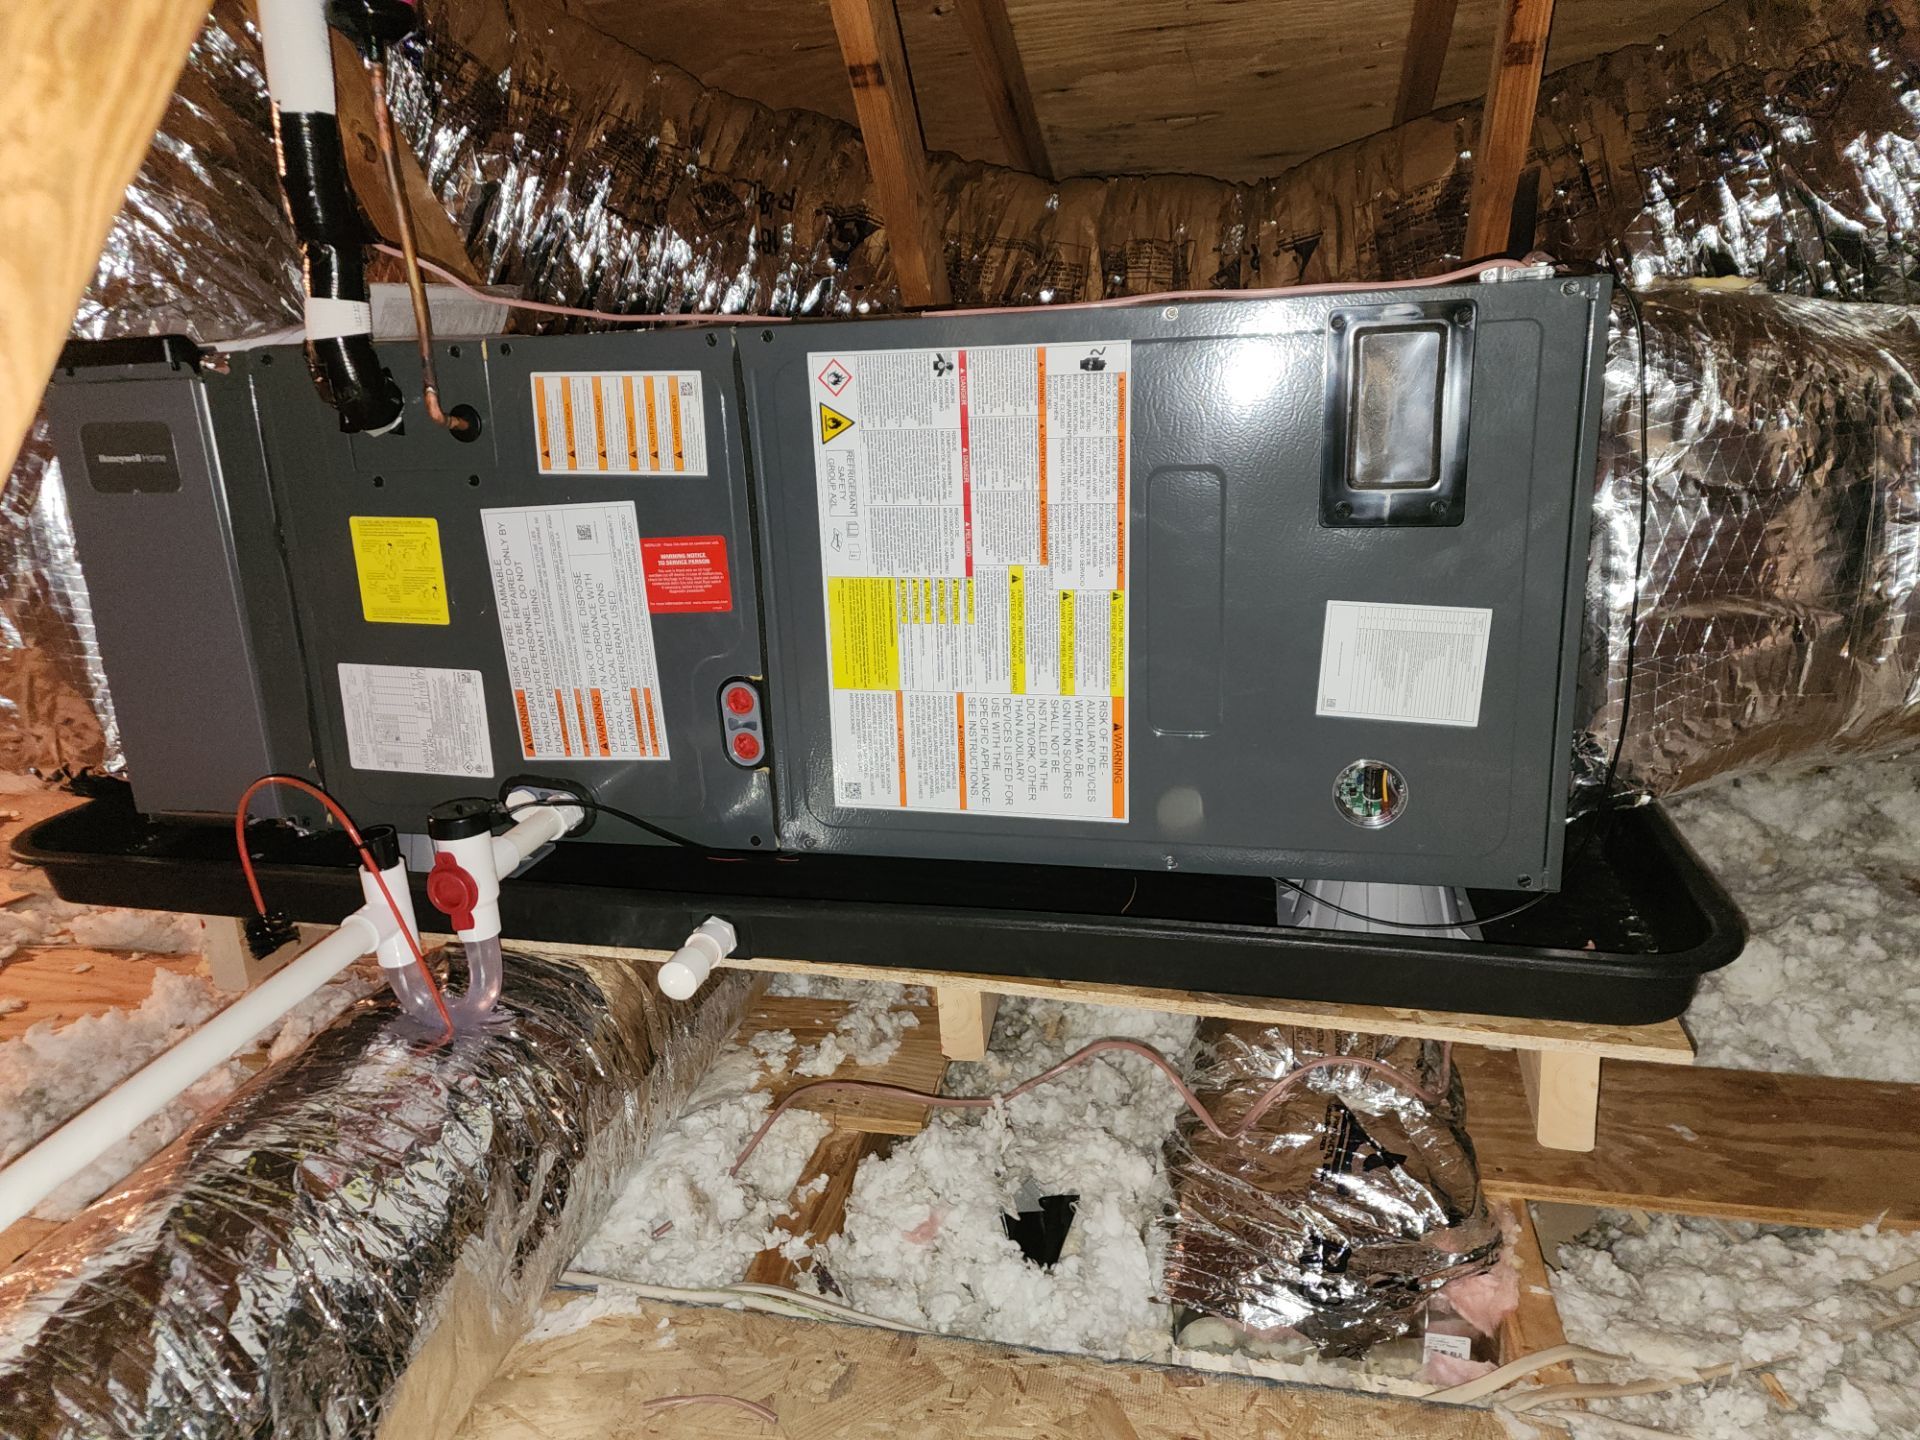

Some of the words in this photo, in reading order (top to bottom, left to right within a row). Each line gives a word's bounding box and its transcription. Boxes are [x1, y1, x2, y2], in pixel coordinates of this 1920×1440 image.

[98, 453, 142, 465] Honeywell
[827, 457, 836, 490] GROUP
[837, 465, 846, 500] SAFETY
[846, 450, 856, 513] REFRIGERANT
[829, 493, 837, 508] A2L
[497, 521, 507, 535] BY
[500, 537, 512, 566] ONLY
[514, 560, 525, 581] NOT
[493, 559, 510, 618] FLAMMABLE
[505, 567, 521, 618] REPAIRED
[518, 584, 528, 599] DO
[573, 571, 587, 615] DISPOSE
[584, 573, 595, 599] WITH
[514, 621, 523, 635] BE
[1010, 613, 1016, 621] DE
[517, 637, 526, 650] TO
[588, 602, 606, 672] ACCORDANCE
[508, 648, 518, 662] OF
[535, 628, 554, 697] REFRIGERANT
[584, 646, 594, 659] OF
[612, 623, 629, 691] REFRIGERANT
[1011, 659, 1017, 667] LA
[511, 665, 522, 687] RISK
[532, 667, 546, 709] SERVICE
[587, 663, 597, 685] RISK
[599, 675, 608, 684] IN
[607, 658, 619, 688] LOCAL
[612, 691, 621, 705] OR
[967, 696, 976, 716] SEE
[990, 697, 999, 718] USE
[1014, 698, 1023, 726] THAN
[1099, 700, 1107, 724] RISK
[517, 696, 532, 742] WARNING
[525, 687, 543, 753] REFRIGERANT
[547, 700, 563, 752] PUNCTURE
[591, 695, 606, 742] WARNING
[622, 694, 638, 752] FLAMMABLE
[979, 697, 988, 744] SPECIFIC
[1002, 697, 1011, 743] DEVICES
[1025, 698, 1035, 762] DUCTWORK,
[1038, 699, 1047, 755] INSTALLED
[1050, 699, 1059, 732] SHALL
[1062, 699, 1071, 745] IGNITION
[1074, 700, 1083, 735] WHICH
[1086, 700, 1095, 754] AUXILIARY
[539, 711, 553, 751] TRAINED
[614, 710, 628, 752] FEDERAL
[991, 721, 1000, 748] WITH
[1050, 735, 1059, 756] NOT
[1099, 728, 1107, 742] OF
[968, 720, 978, 798] INSTRUCTIONS.
[992, 751, 1000, 770] THE
[1003, 745, 1012, 781] LISTED
[1015, 728, 1024, 781] AUXILIARY
[1039, 758, 1047, 768] IN
[1074, 738, 1083, 760] MAY
[1099, 745, 1107, 768] FIRE
[1113, 733, 1122, 784] WARNING
[1051, 759, 1059, 773] BE
[1062, 748, 1071, 799] SOURCES
[1074, 763, 1083, 776] BE
[1086, 757, 1095, 802] DEVICES
[1004, 784, 1013, 805] FOR
[1027, 765, 1036, 800] OTHER
[1039, 772, 1048, 791] THE
